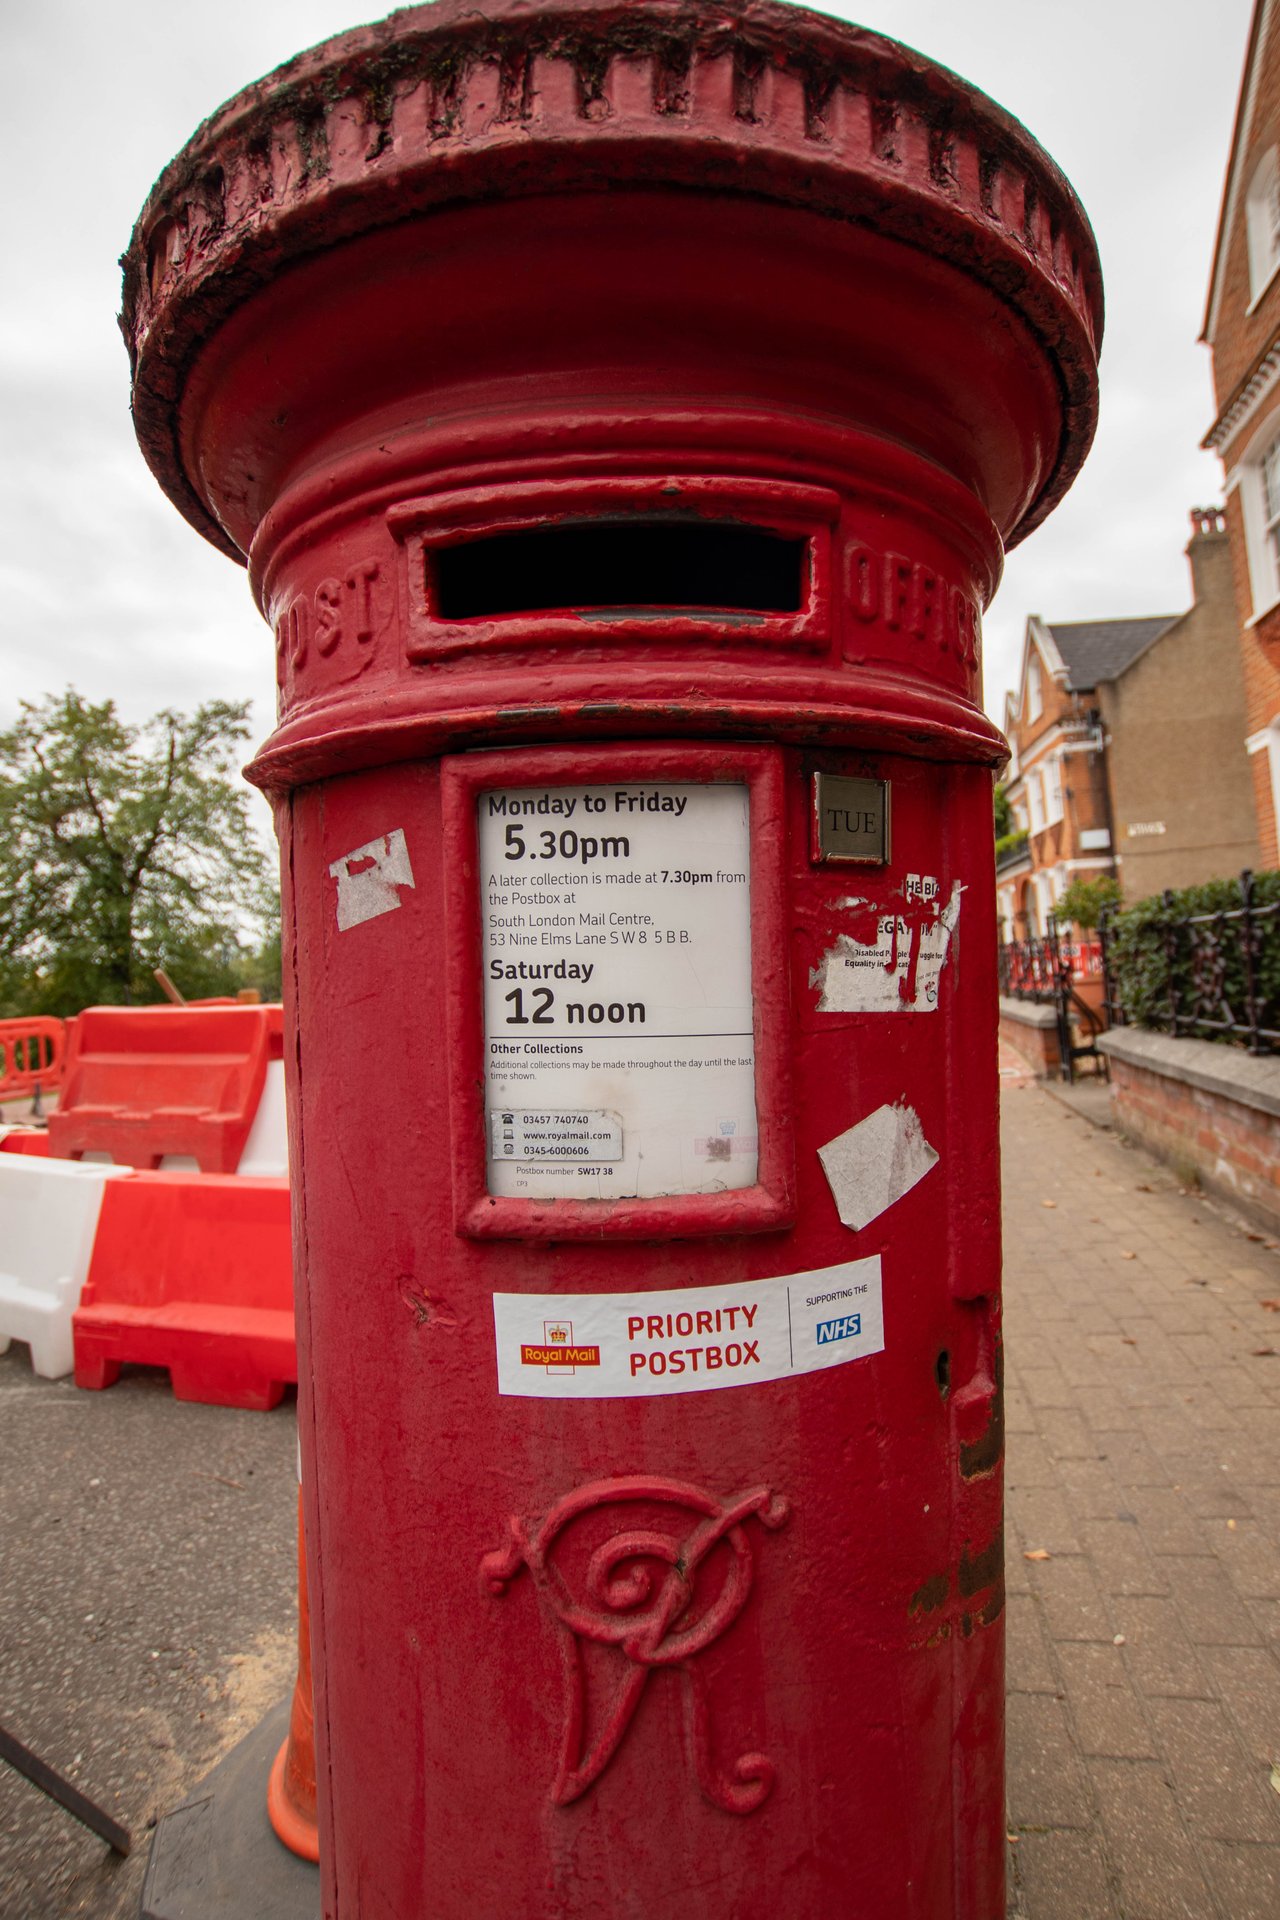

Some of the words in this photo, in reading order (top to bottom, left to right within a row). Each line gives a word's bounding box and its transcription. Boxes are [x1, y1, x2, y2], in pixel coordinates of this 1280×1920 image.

[489, 795, 576, 818] Monday
[583, 795, 606, 812] to
[615, 791, 687, 816] Friday
[828, 809, 876, 834] TUE
[505, 824, 629, 864] 5.30pm
[489, 874, 497, 886] A
[500, 875, 527, 886] later
[531, 873, 588, 885] collection
[593, 872, 601, 884] is
[606, 872, 641, 883] made
[645, 872, 657, 883] at
[661, 871, 712, 885] 7.30pm
[717, 870, 745, 883] from
[489, 893, 508, 905] the
[512, 892, 560, 904] Postbox
[564, 892, 576, 903] at
[490, 915, 525, 927] South
[529, 914, 575, 926] London
[580, 913, 605, 925] Mail
[609, 913, 654, 925] Centre,
[490, 933, 505, 946] 53
[510, 933, 537, 945] Nine
[542, 933, 571, 945] Elms
[576, 932, 606, 944] Lane
[491, 959, 593, 983] Saturday
[845, 960, 875, 969] Equality
[505, 987, 554, 1024] 12
[566, 1003, 645, 1024] noon
[491, 1044, 521, 1053] Other
[524, 1044, 583, 1053] Collections
[530, 1061, 570, 1069] collections
[628, 1060, 672, 1069] throughout
[689, 1059, 702, 1068] day
[705, 1058, 721, 1066] until
[724, 1058, 736, 1066] the
[491, 1072, 508, 1080] time
[523, 1116, 550, 1124] 03457
[555, 1116, 588, 1124] 740740
[523, 1132, 611, 1141] www.royalmail.com
[516, 1166, 544, 1174] Postbox
[806, 1288, 853, 1307] SUPPORTING
[853, 1284, 868, 1298] THE
[628, 1304, 758, 1340] PRIORITY
[818, 1316, 860, 1342] NHS
[525, 1348, 562, 1363] Royal
[565, 1349, 595, 1362] Mail
[630, 1340, 760, 1377] POSTBOX
